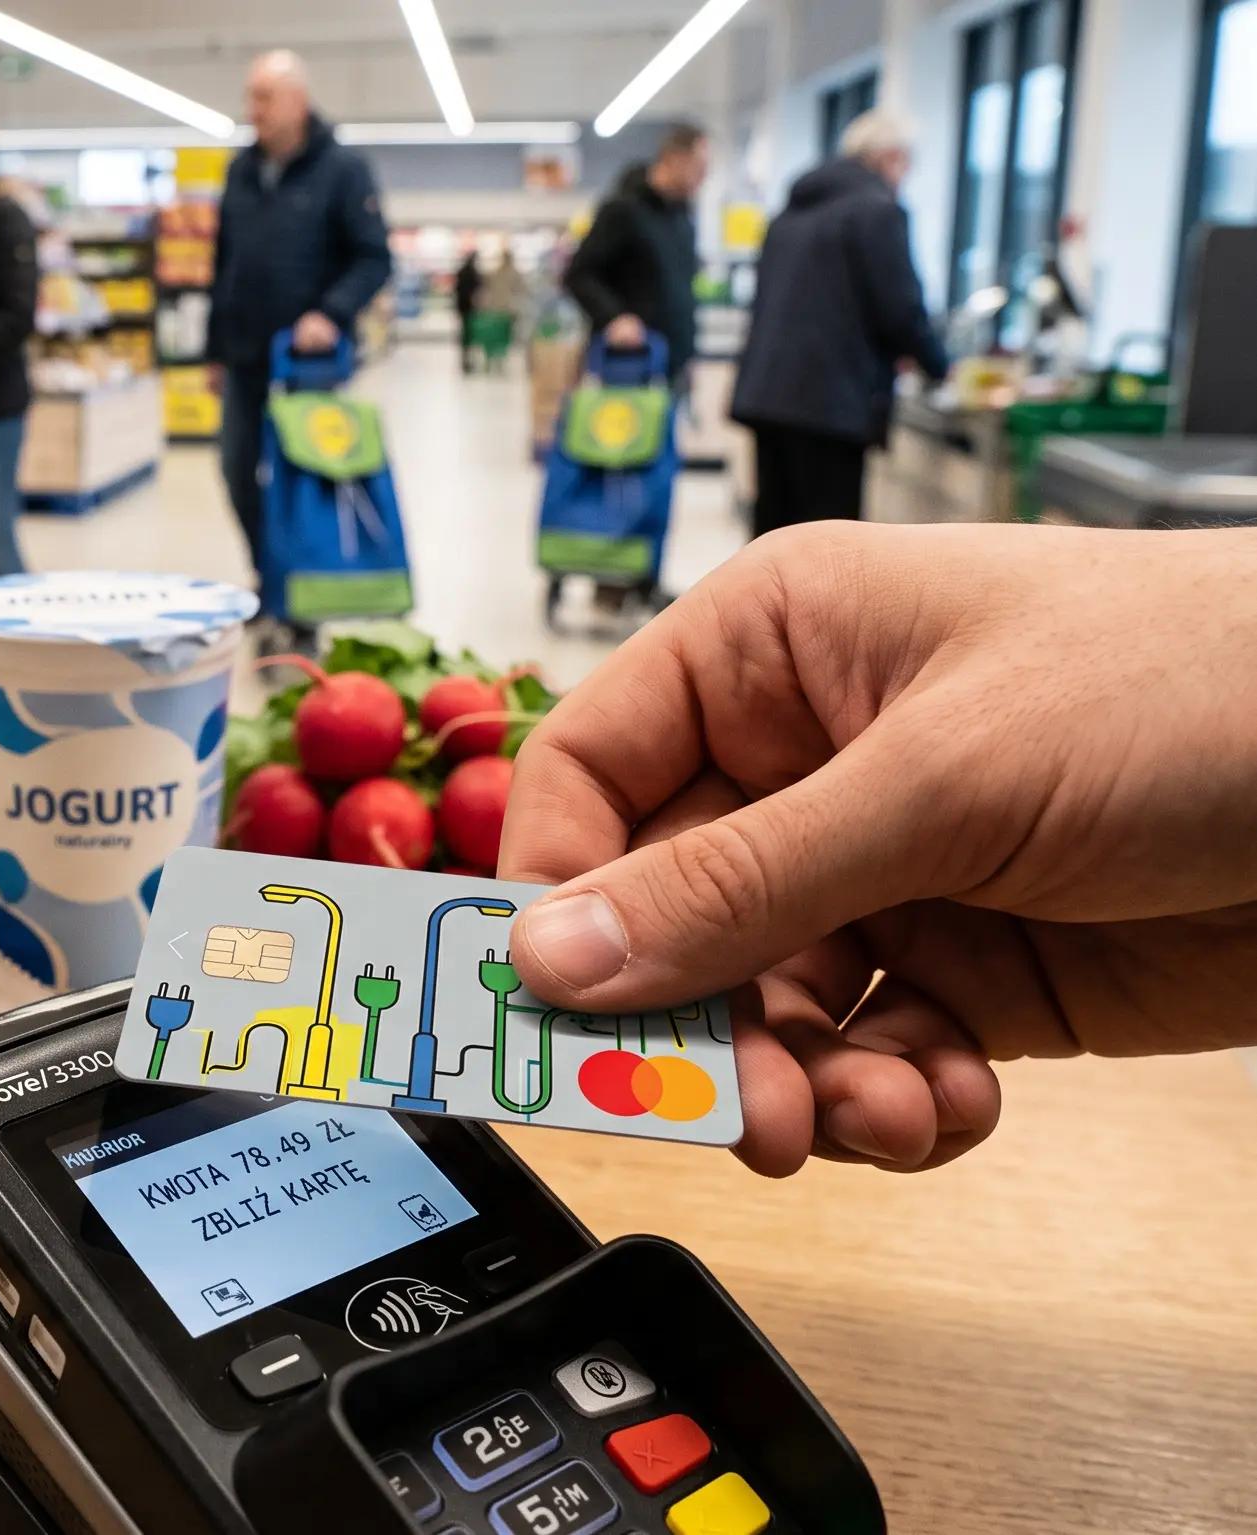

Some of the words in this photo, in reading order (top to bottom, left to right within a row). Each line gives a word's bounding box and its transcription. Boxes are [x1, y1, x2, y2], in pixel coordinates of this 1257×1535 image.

[6, 782, 180, 826] JOGURT
[138, 1163, 230, 1209] KWOTA
[231, 1131, 311, 1174] 78.49
[315, 1118, 356, 1143] ZŁ
[280, 1159, 371, 1206] KARTĘ
[462, 1426, 505, 1464] 2
[516, 1494, 560, 1535] 5
